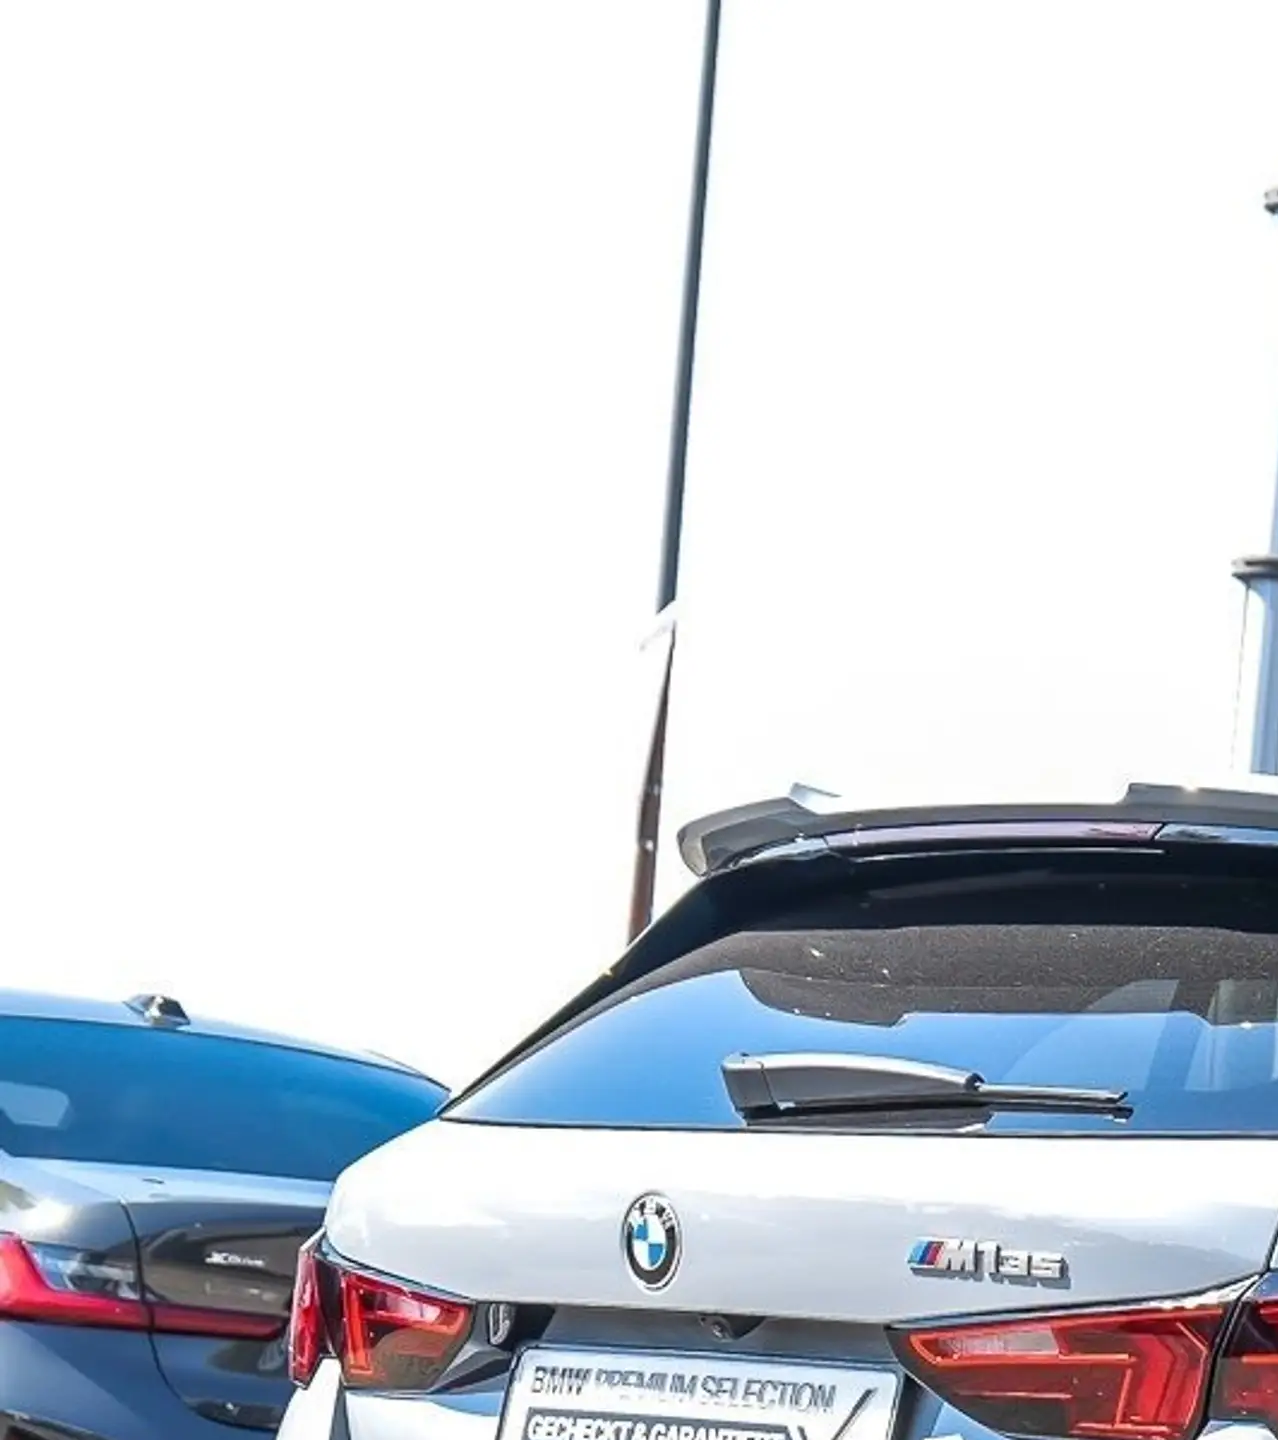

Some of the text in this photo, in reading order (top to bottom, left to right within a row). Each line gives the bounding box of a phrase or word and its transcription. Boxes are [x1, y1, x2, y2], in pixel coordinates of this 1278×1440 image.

[935, 1237, 1064, 1278] M135
[531, 1365, 591, 1397] BMW
[700, 1374, 837, 1414] SELECTION
